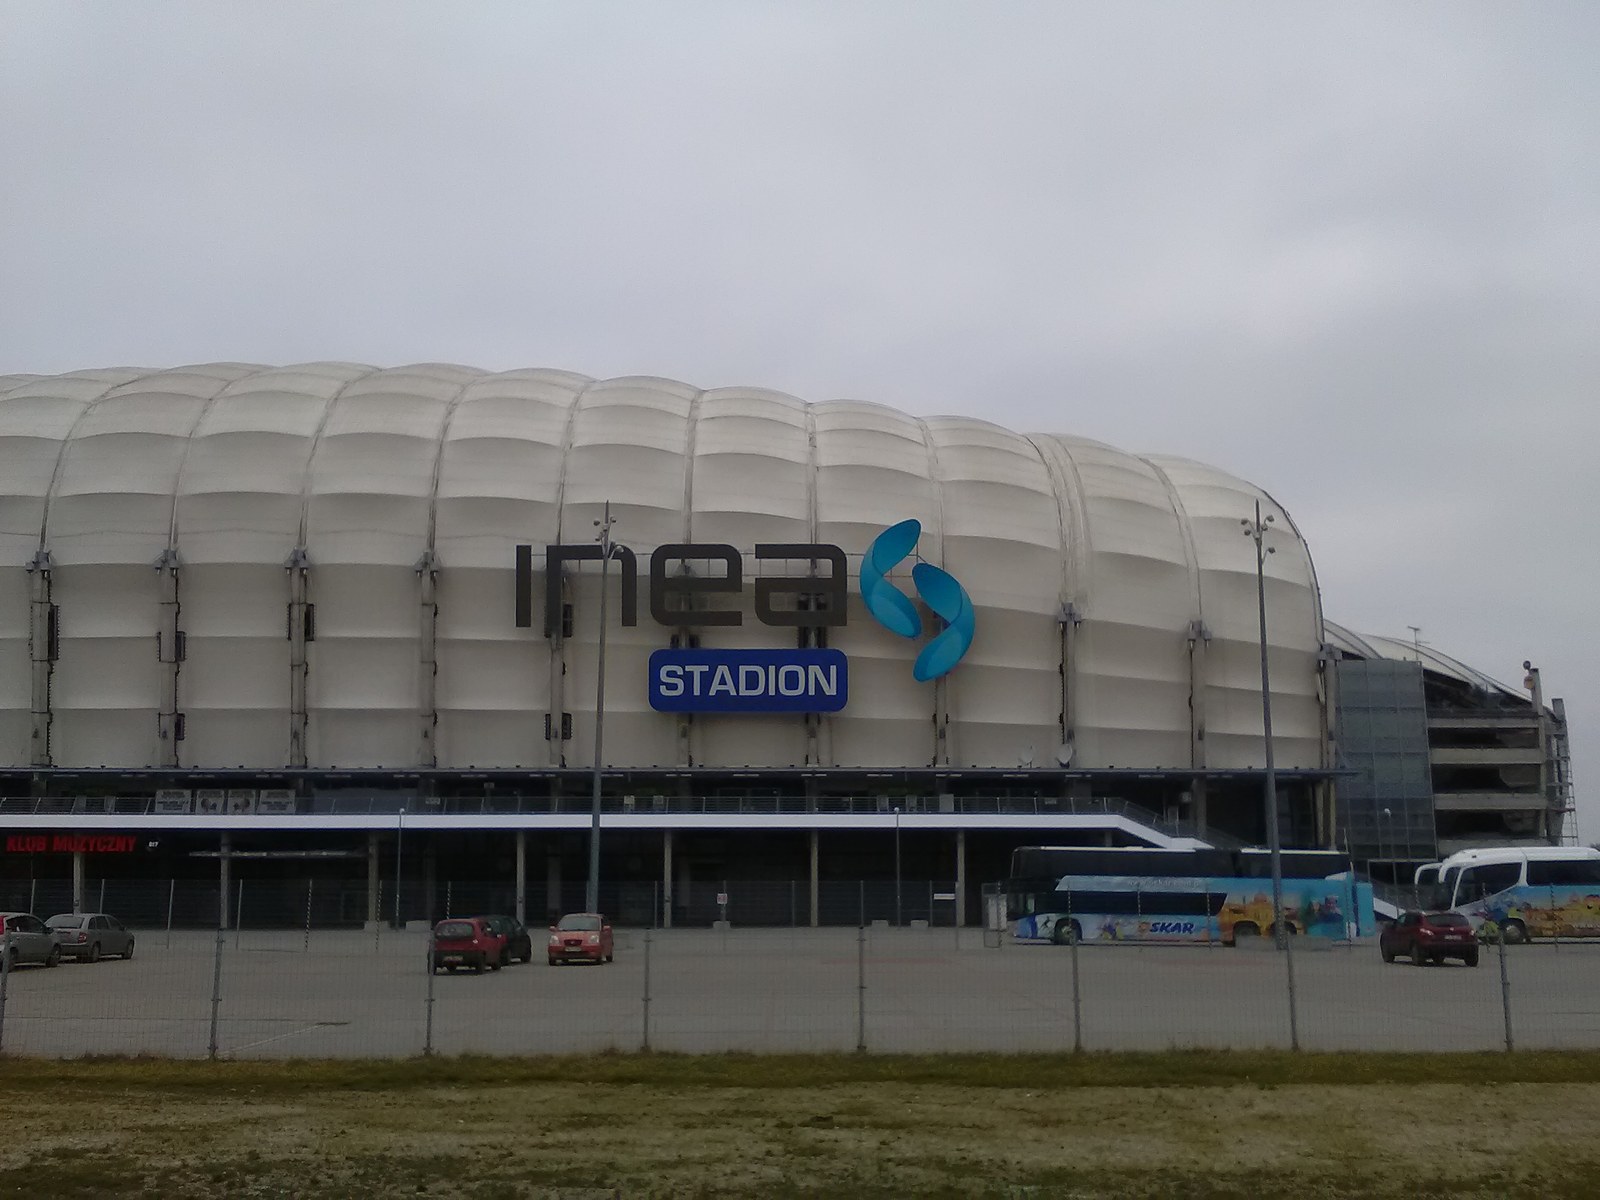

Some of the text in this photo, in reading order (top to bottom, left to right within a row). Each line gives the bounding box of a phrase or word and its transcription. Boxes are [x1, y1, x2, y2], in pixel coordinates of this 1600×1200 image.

[660, 664, 836, 697] STADION
[7, 835, 136, 852] KLUB MUZYCZNY
[1150, 922, 1194, 934] SKAR
